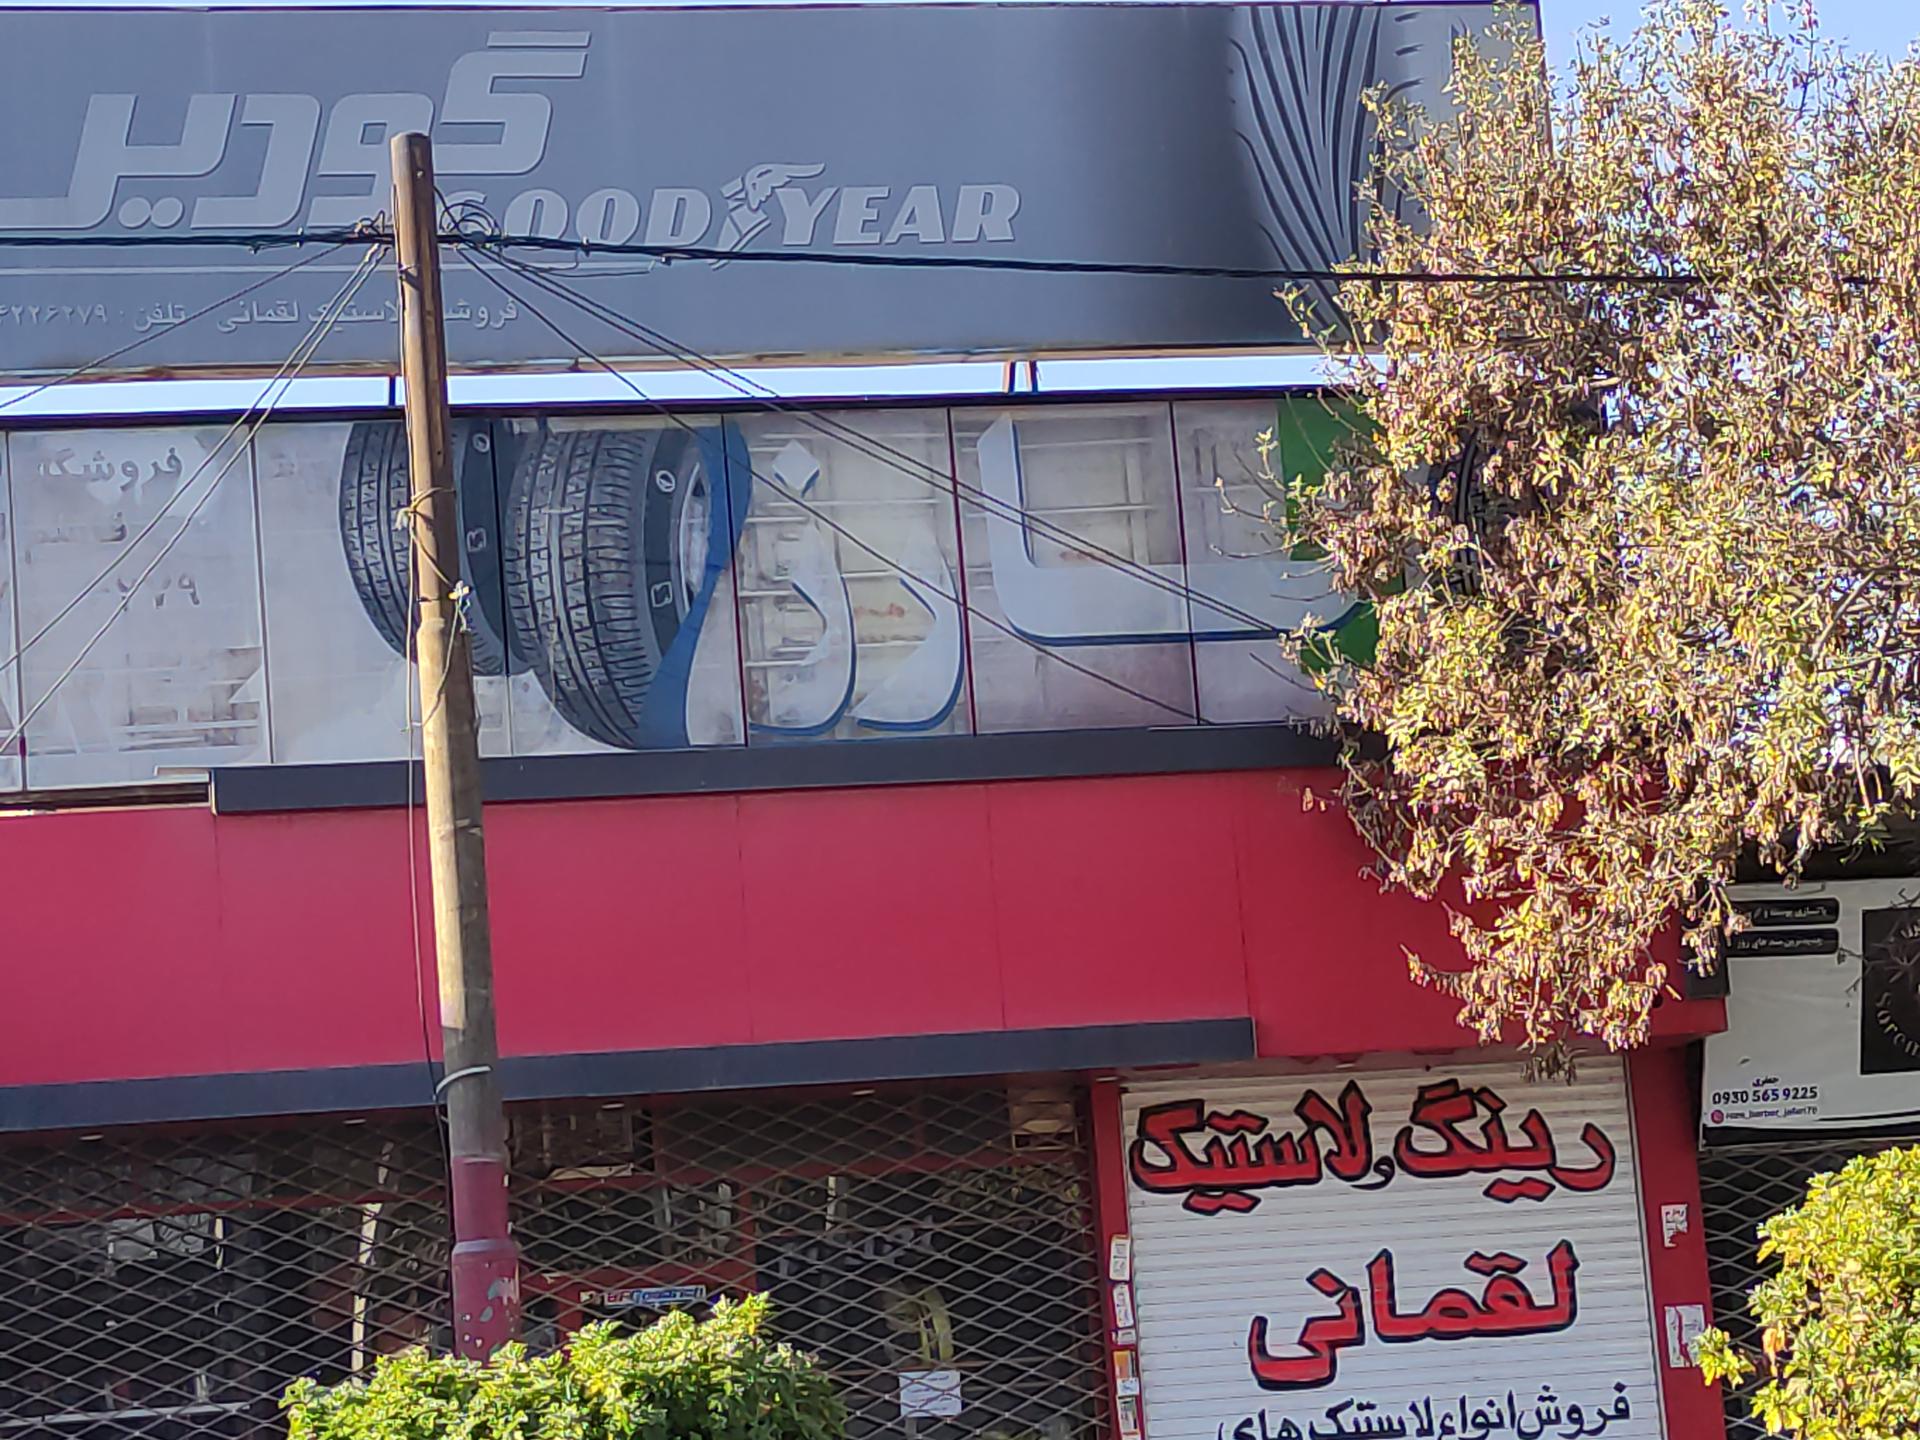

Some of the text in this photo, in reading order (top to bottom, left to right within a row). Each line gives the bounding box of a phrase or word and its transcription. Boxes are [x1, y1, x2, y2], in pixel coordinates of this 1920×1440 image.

[216, 299, 299, 334] لقمانی
[1712, 1086, 1818, 1105] 0930 565 9225
[1129, 1080, 1373, 1216] لاستیک
[1395, 1078, 1616, 1203] رینگ
[1248, 1240, 1581, 1391] لقمانی
[1438, 1389, 1517, 1440] انواع
[1516, 1381, 1631, 1437] فروش
